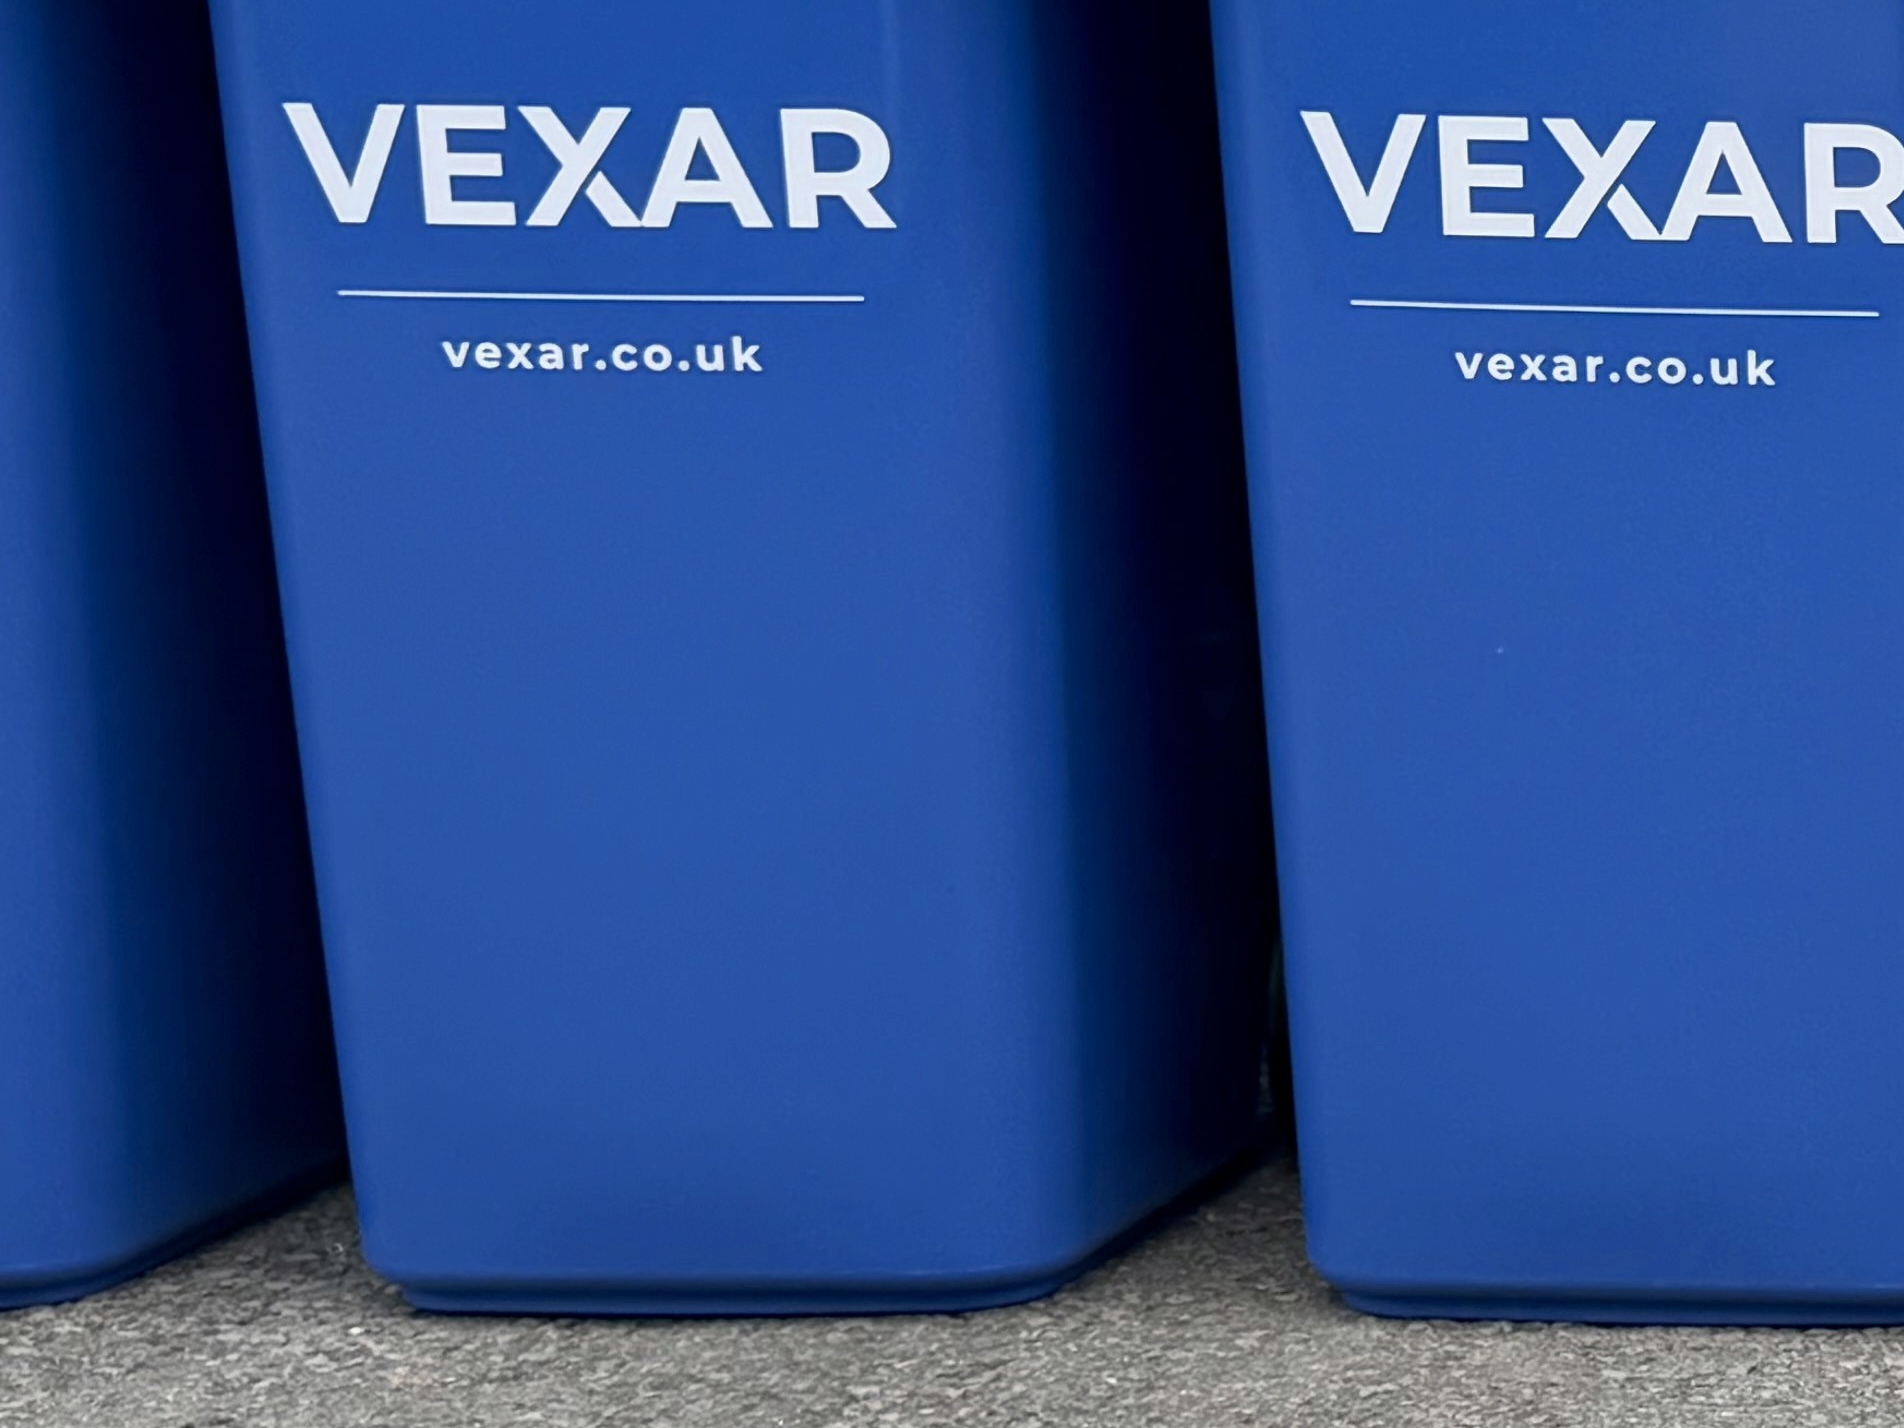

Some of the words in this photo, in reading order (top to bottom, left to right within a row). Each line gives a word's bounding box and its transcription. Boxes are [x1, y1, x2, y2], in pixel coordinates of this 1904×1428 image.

[281, 101, 898, 230] VEXAR
[441, 334, 764, 373] vexar.co.uk
[1454, 348, 1777, 387] vexar.co.uk
